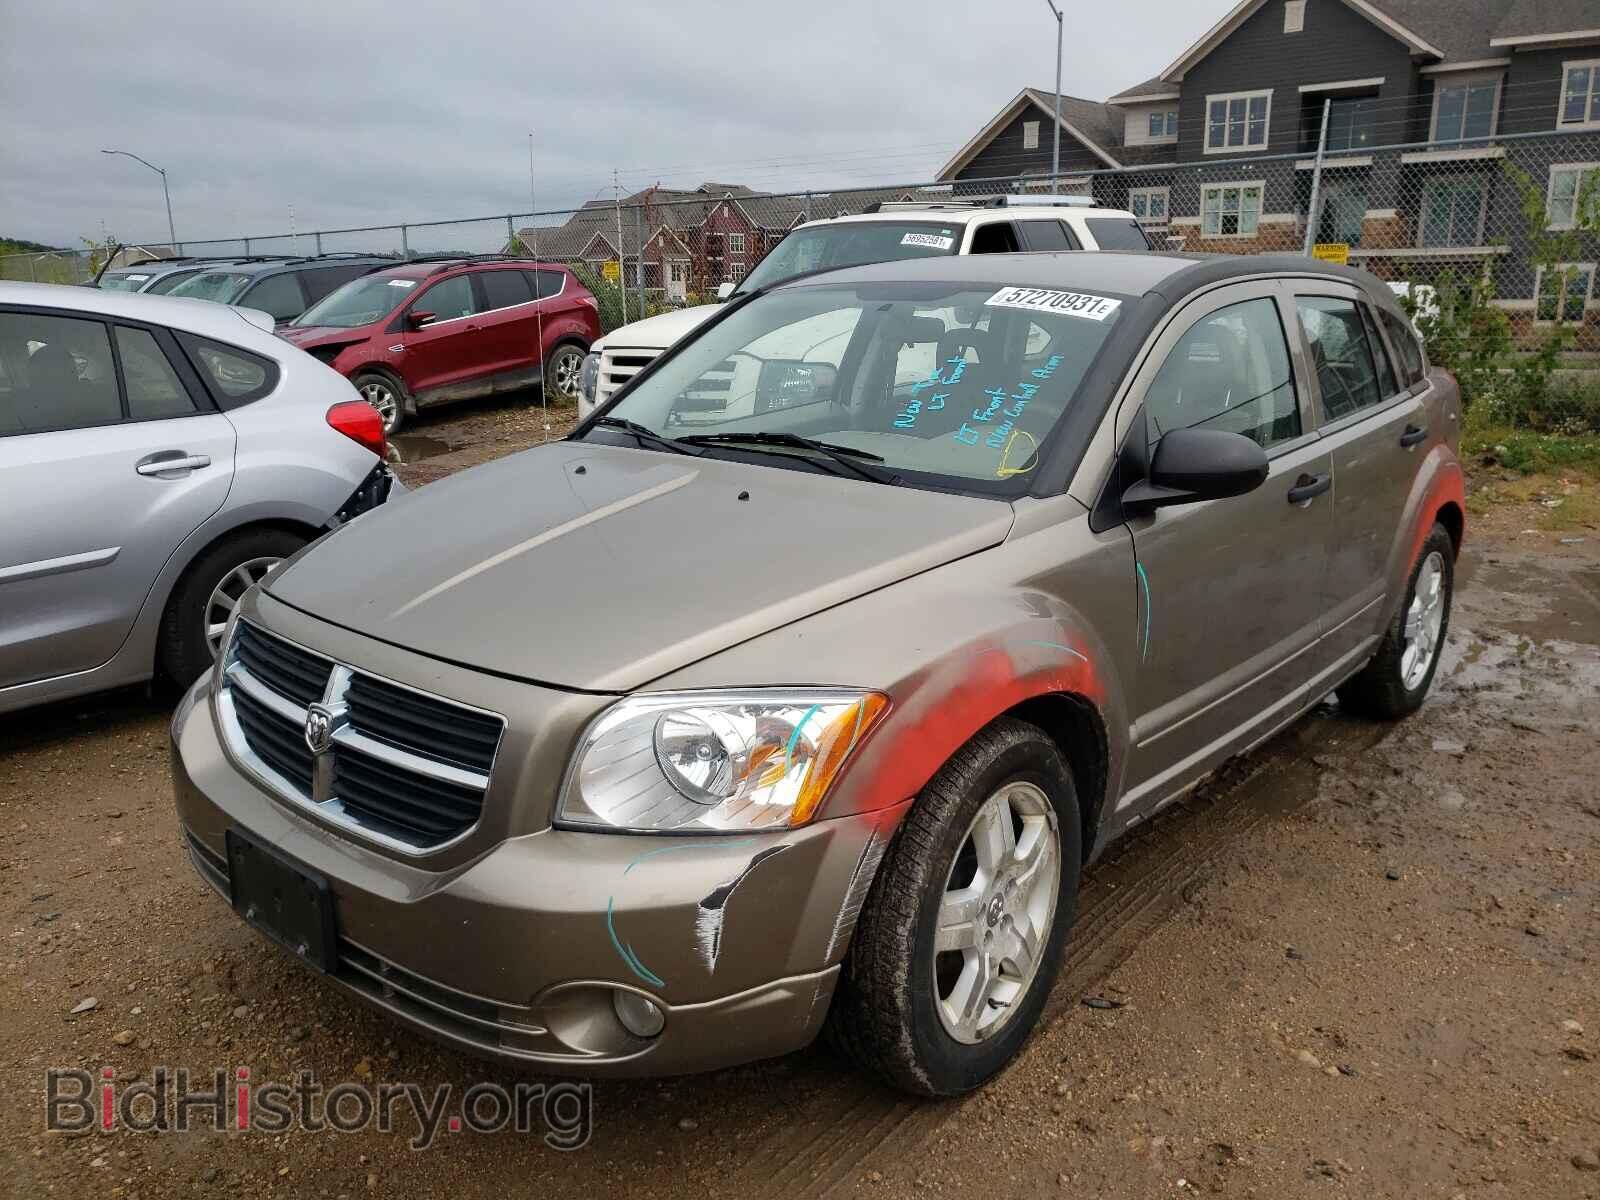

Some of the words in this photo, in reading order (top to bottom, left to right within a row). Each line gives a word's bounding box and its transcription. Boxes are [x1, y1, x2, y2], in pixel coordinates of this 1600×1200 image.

[1005, 288, 1103, 313] 57270931
[1032, 354, 1064, 380] Arm
[893, 400, 922, 429] New
[972, 387, 1006, 422] Front
